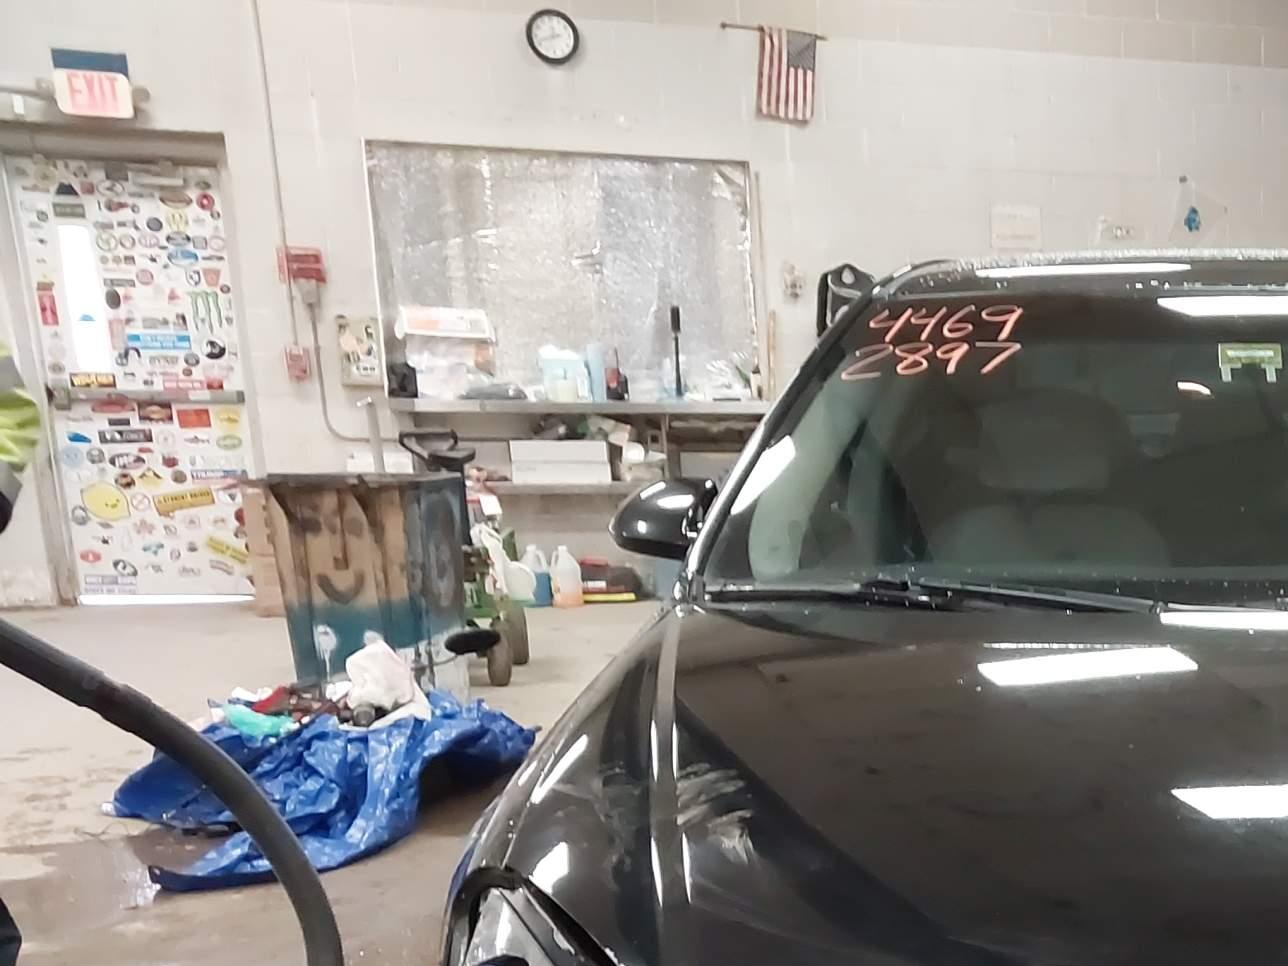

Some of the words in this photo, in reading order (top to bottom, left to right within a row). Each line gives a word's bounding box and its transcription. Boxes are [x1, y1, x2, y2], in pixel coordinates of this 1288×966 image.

[66, 71, 119, 113] EXIT
[869, 304, 1023, 343] 4469
[841, 341, 1022, 381] 2897
